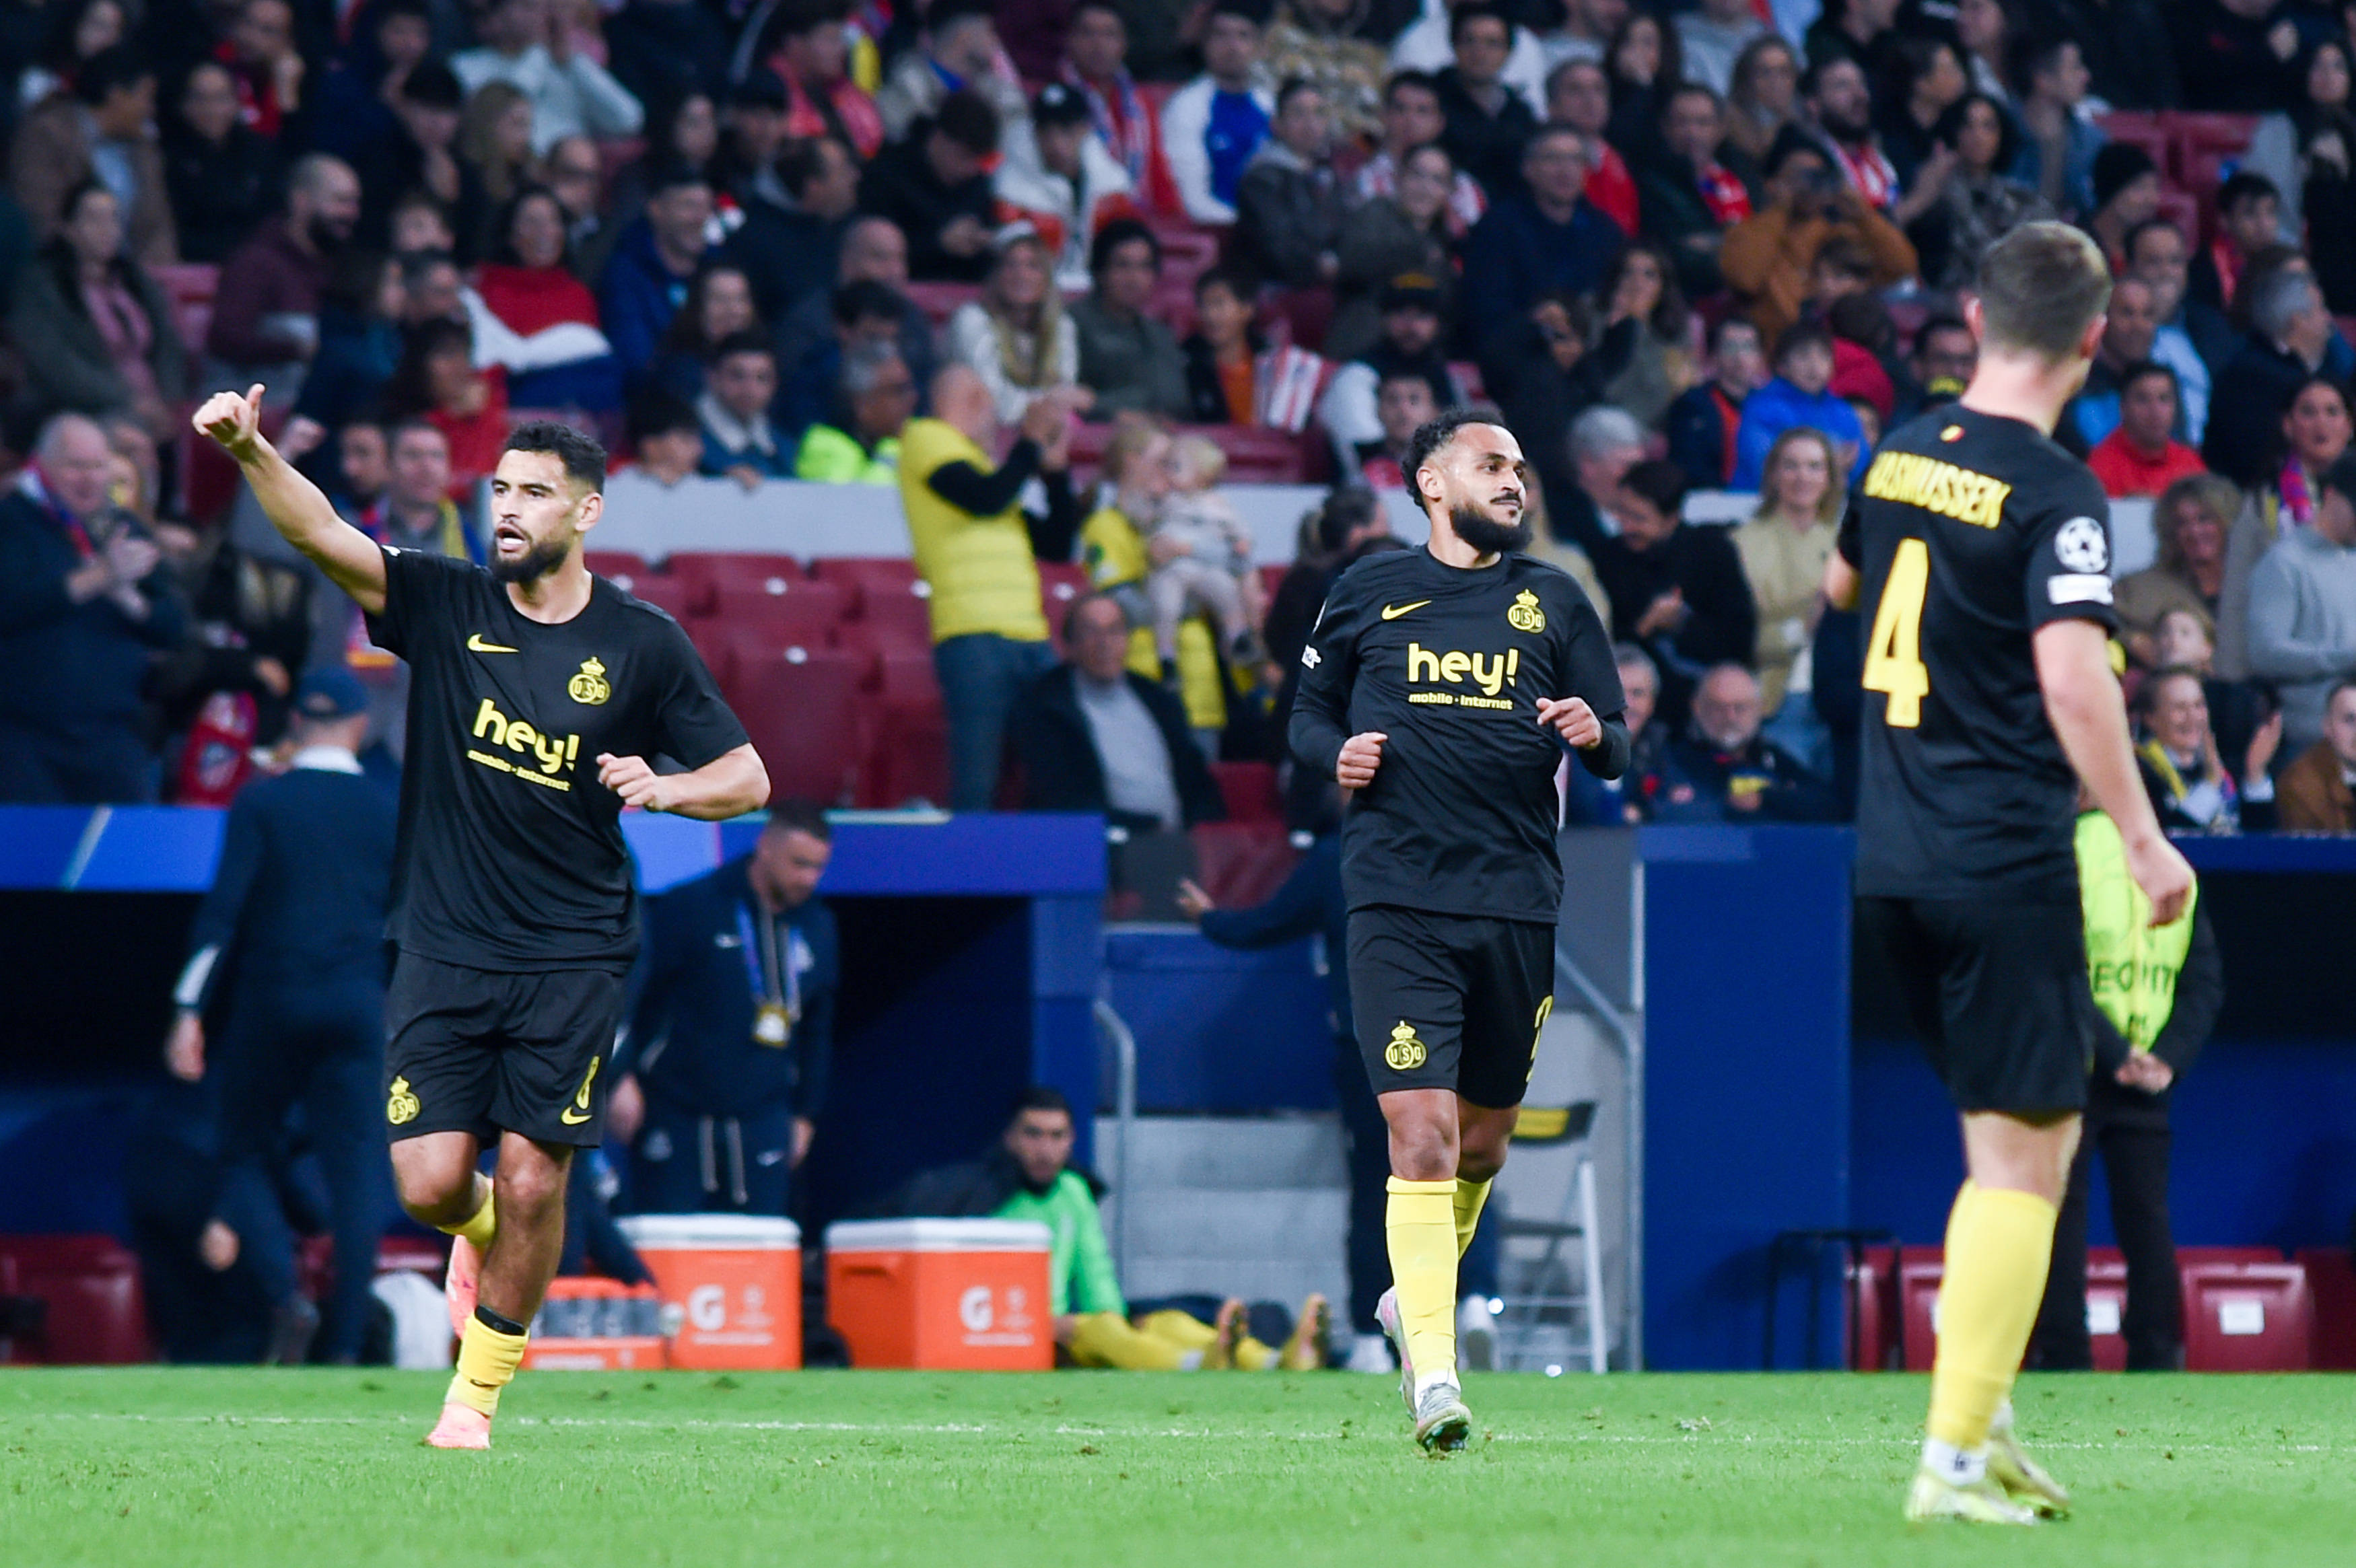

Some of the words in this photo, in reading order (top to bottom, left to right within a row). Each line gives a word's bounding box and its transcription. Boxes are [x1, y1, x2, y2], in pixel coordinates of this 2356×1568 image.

[1862, 538, 1929, 727] 4
[1408, 643, 1519, 696] hey!
[1408, 692, 1453, 705] mobile
[1460, 694, 1513, 711] internet
[473, 698, 580, 774] hey!
[689, 1283, 726, 1330] G
[959, 1285, 993, 1332] G
